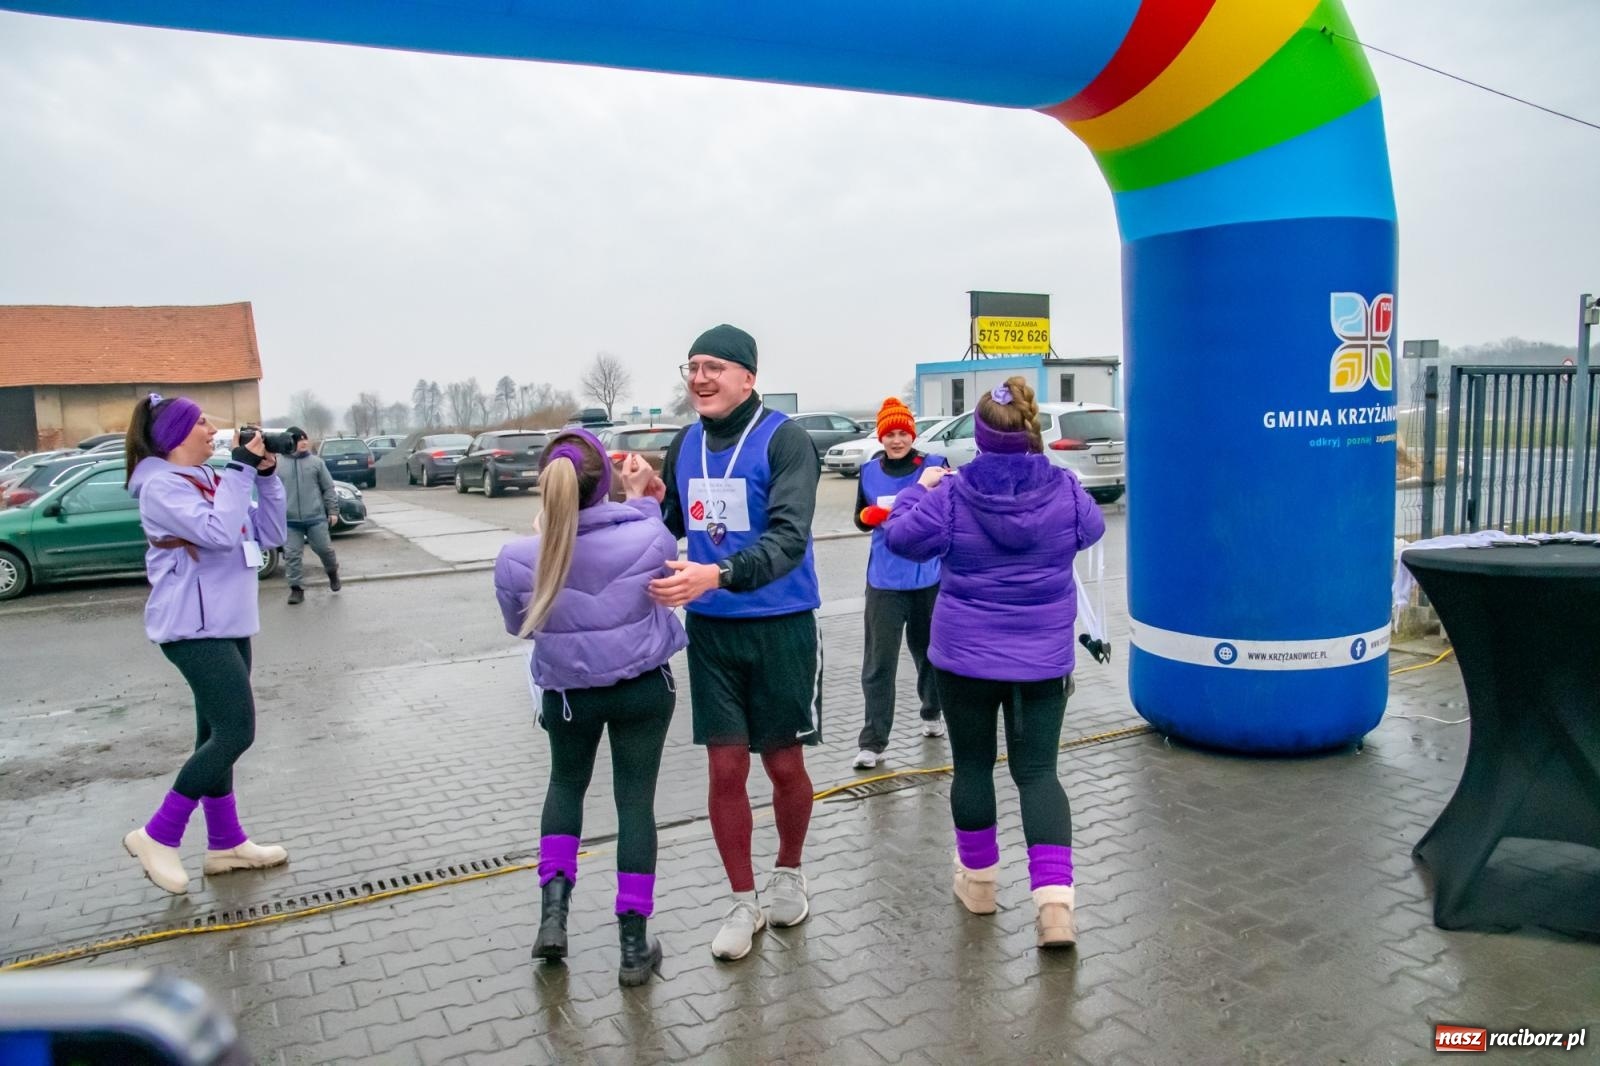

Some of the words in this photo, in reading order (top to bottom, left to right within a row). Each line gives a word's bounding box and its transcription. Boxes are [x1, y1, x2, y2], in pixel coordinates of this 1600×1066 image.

[979, 329, 1000, 342] 575
[1003, 329, 1024, 342] 792
[1027, 330, 1048, 342] 626
[1263, 409, 1332, 428] GMINA
[1309, 437, 1341, 447] odkryj
[705, 500, 727, 519] 22
